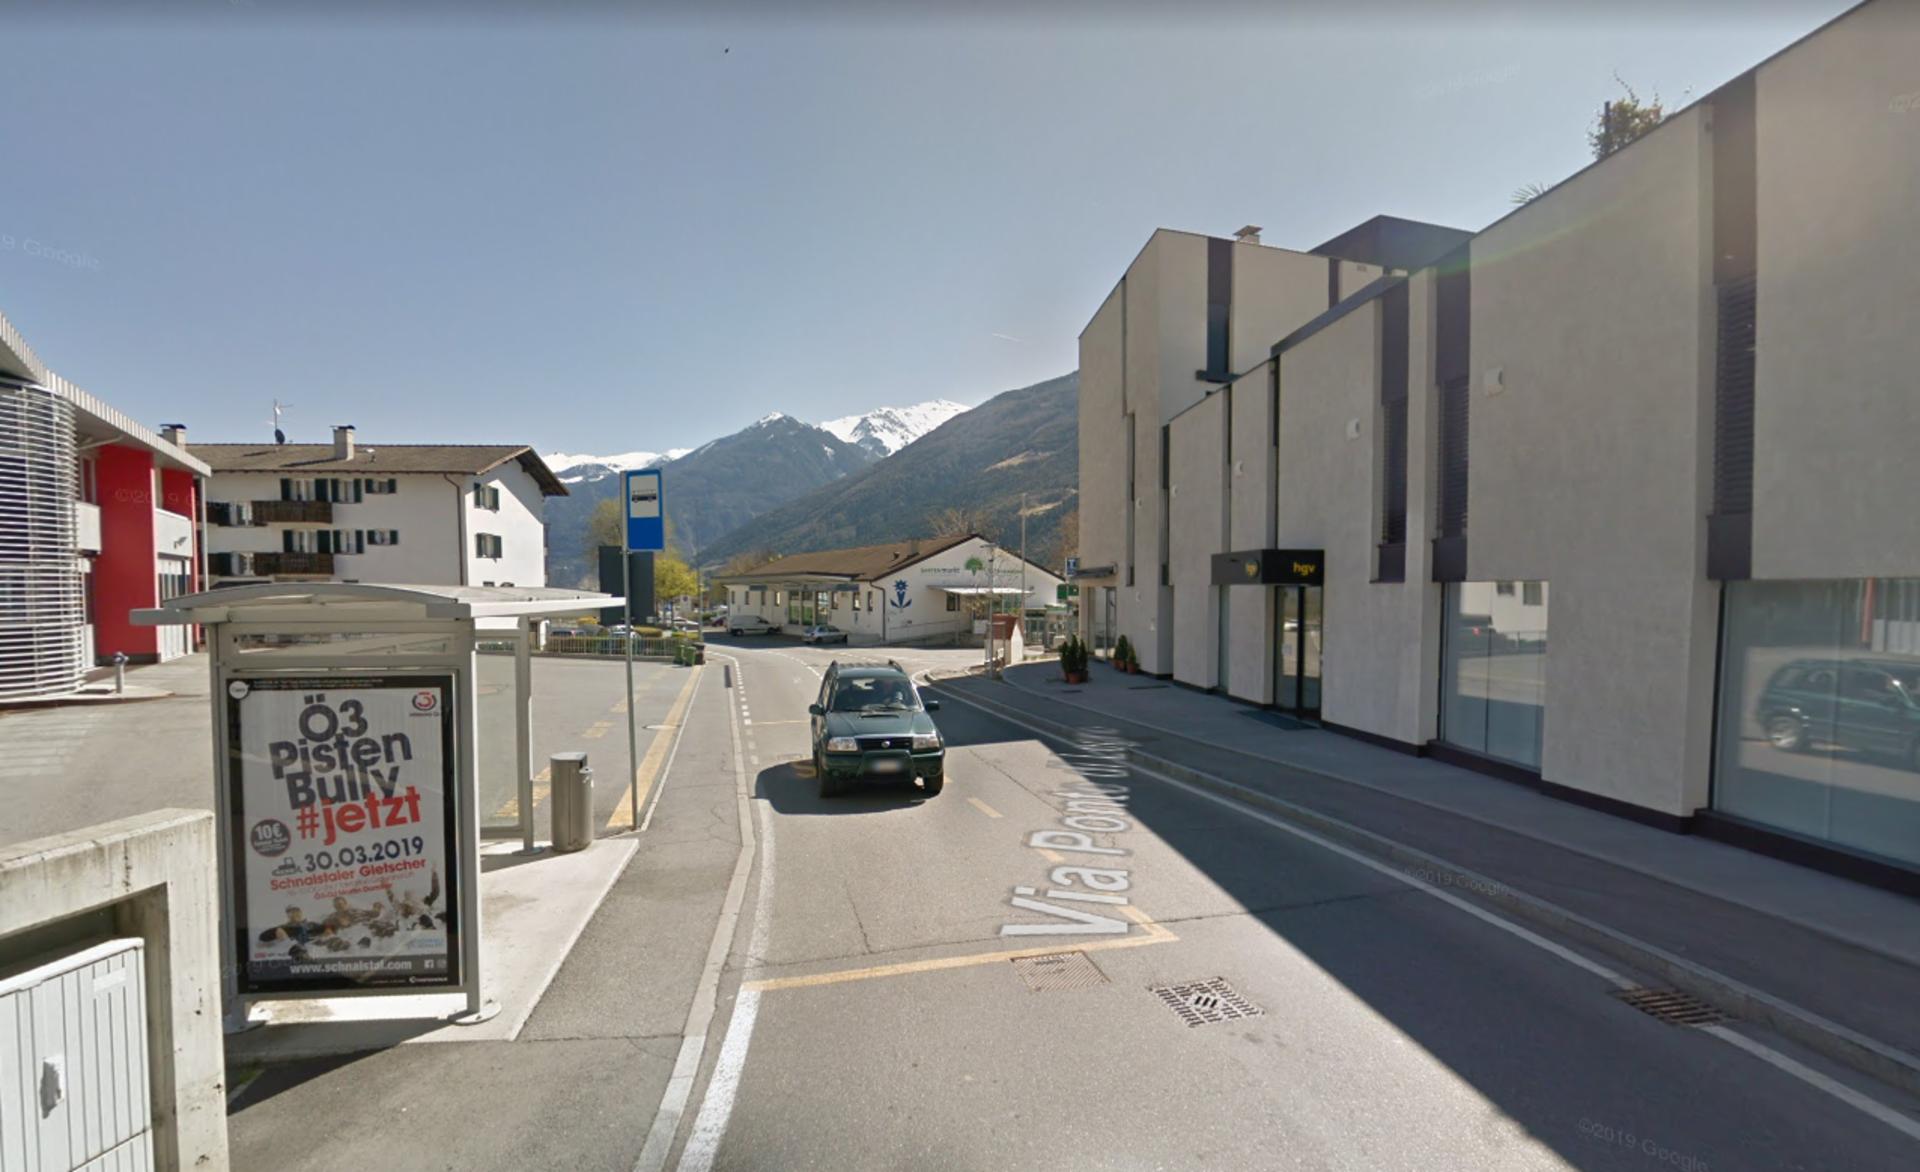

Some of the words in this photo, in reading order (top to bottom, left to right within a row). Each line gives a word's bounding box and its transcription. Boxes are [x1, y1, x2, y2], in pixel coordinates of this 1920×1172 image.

[1292, 561, 1316, 576] hgv
[298, 694, 368, 741] Ö3
[269, 731, 413, 780] Pisten
[287, 766, 400, 809] Bully
[255, 822, 283, 840] 10€
[296, 786, 422, 845] #jetzt
[304, 836, 424, 873] 30.03.2019
[270, 868, 354, 891] Schnalstaler
[359, 858, 427, 877] Gletscher
[289, 958, 413, 976] www.schnalstal.com
